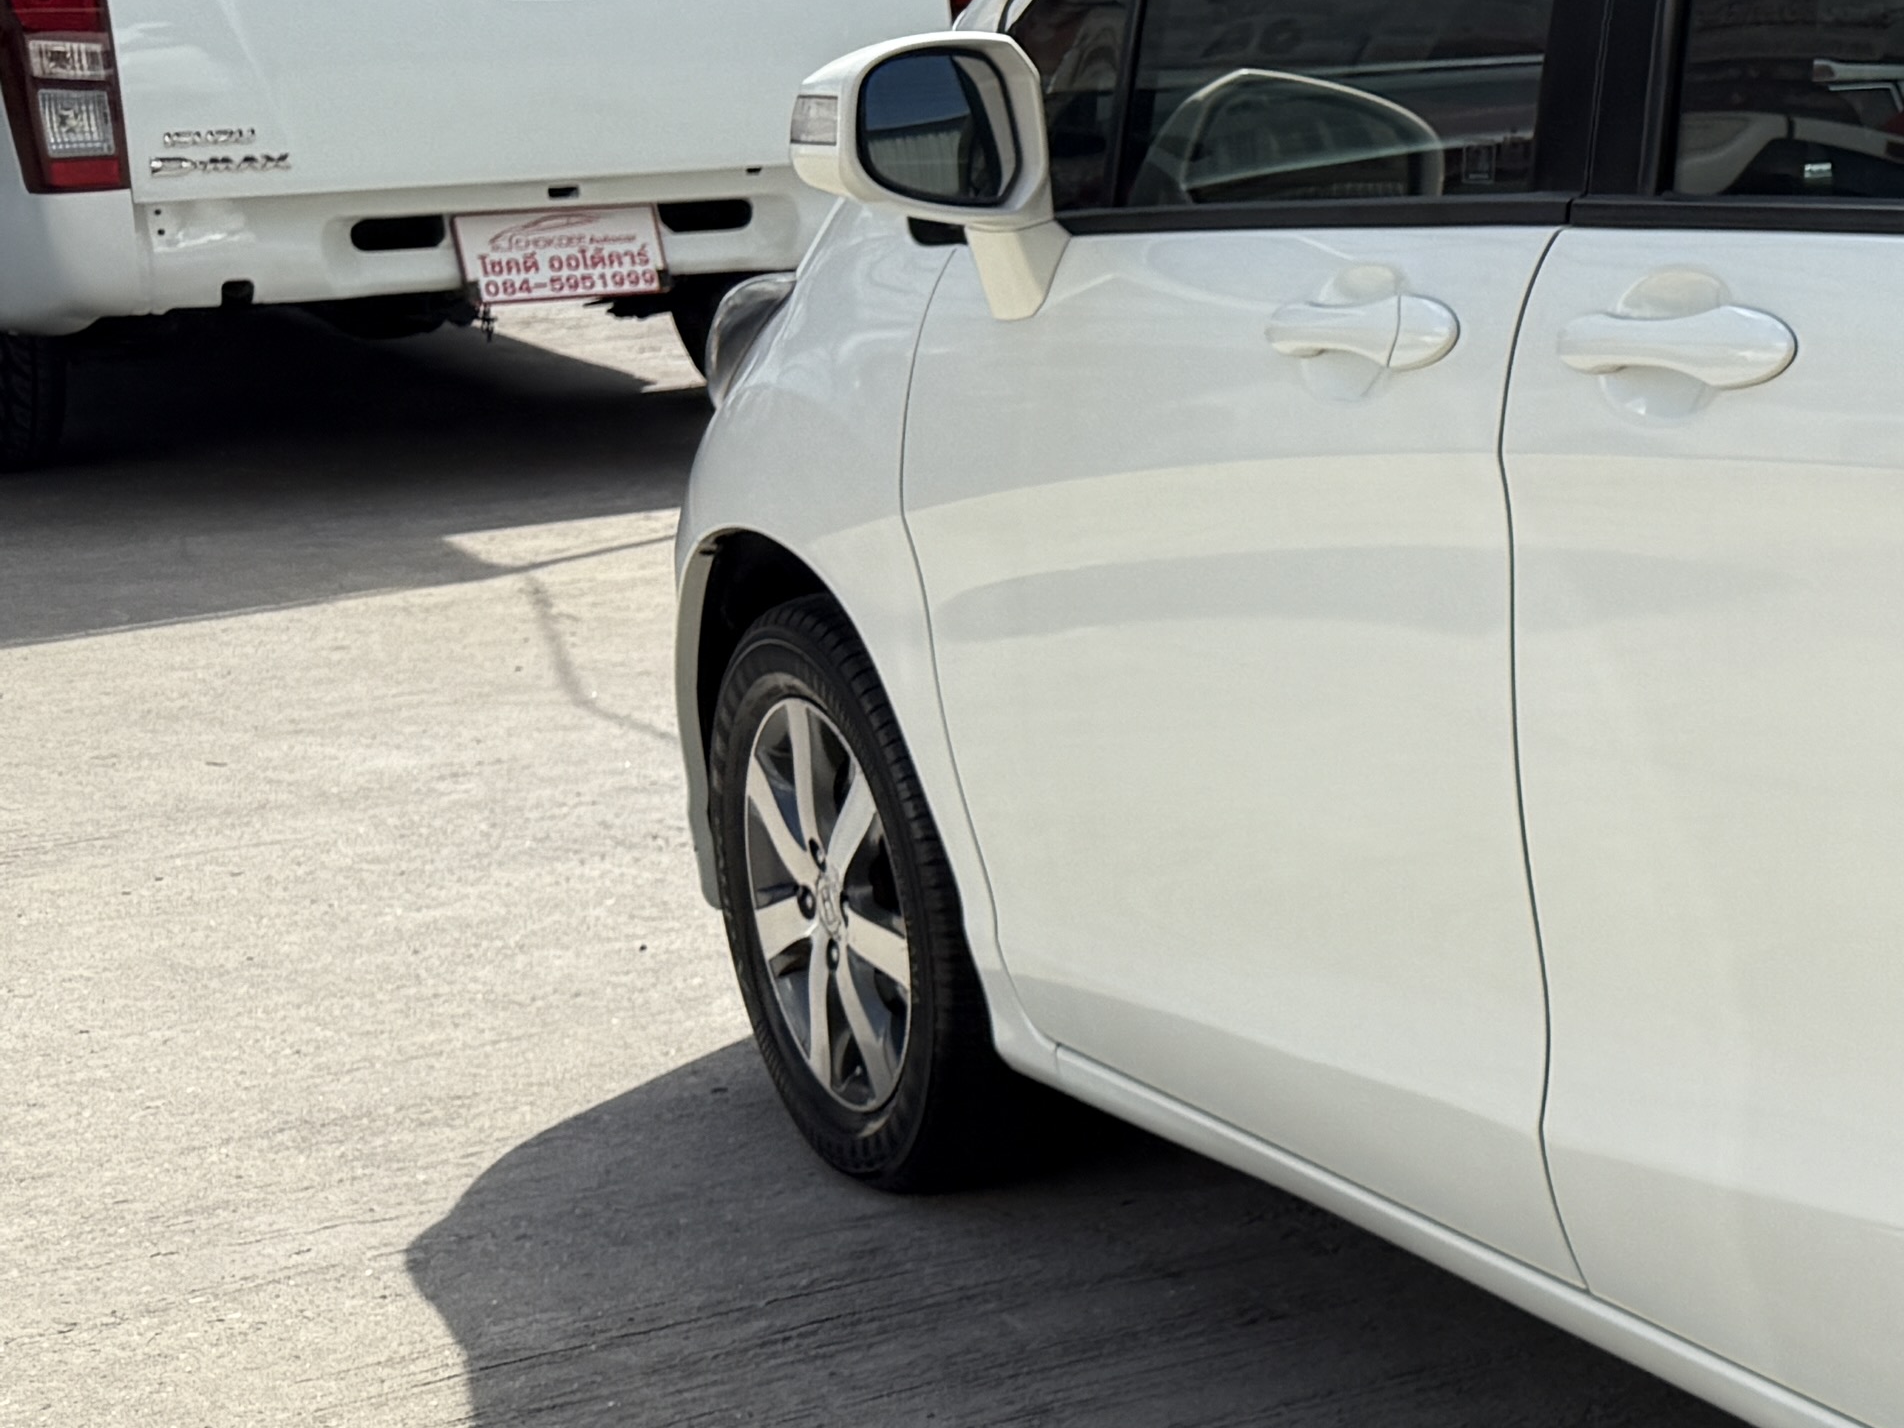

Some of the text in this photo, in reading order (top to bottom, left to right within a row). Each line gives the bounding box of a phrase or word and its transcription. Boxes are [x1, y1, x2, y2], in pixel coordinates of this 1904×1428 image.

[479, 243, 650, 277] โชคดี ออโต้คาร์
[484, 268, 657, 297] 084-5951999
